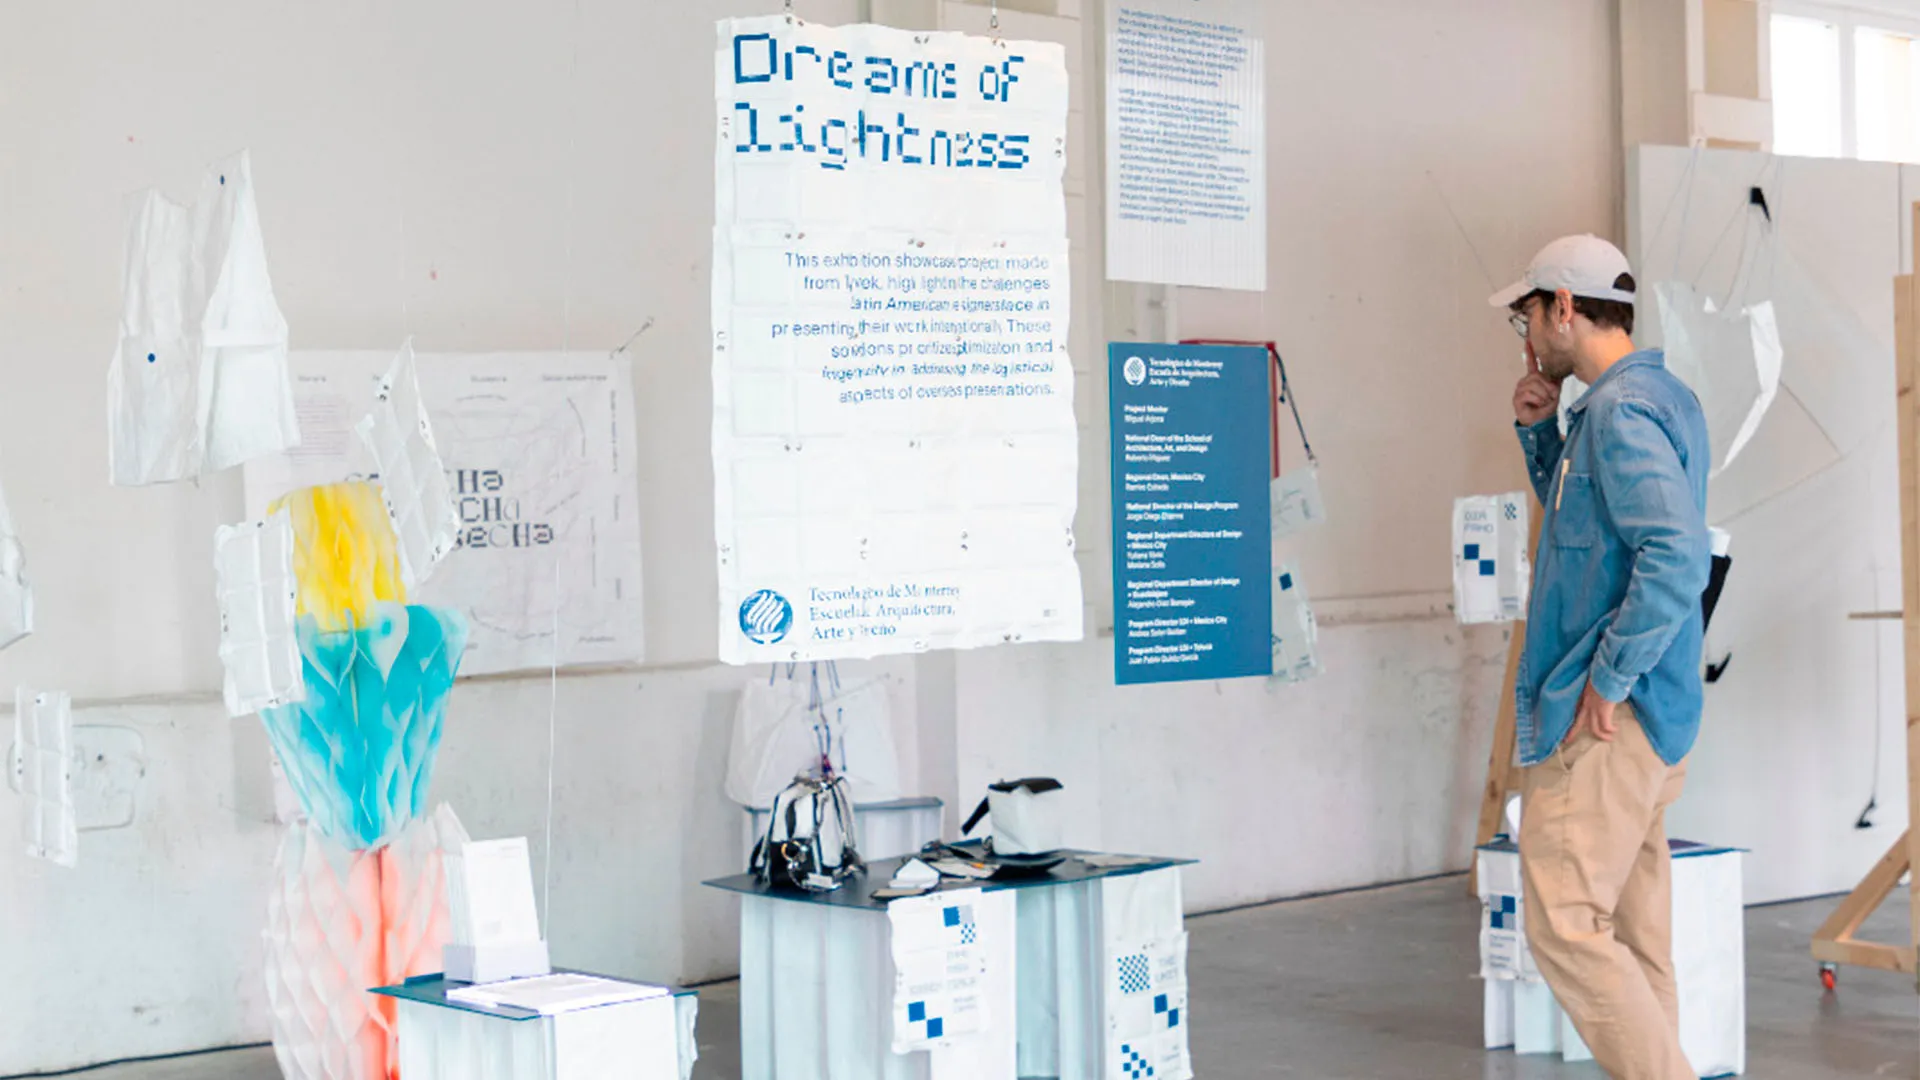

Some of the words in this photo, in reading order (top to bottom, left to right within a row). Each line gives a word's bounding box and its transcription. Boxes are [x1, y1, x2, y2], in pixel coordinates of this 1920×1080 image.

[734, 33, 957, 98] Dreams
[979, 56, 1025, 102] of
[785, 251, 820, 268] This
[1005, 255, 1050, 270] made
[804, 276, 840, 290] from
[1026, 339, 1052, 353] and
[1125, 434, 1149, 442] National
[812, 624, 845, 640] Arte
